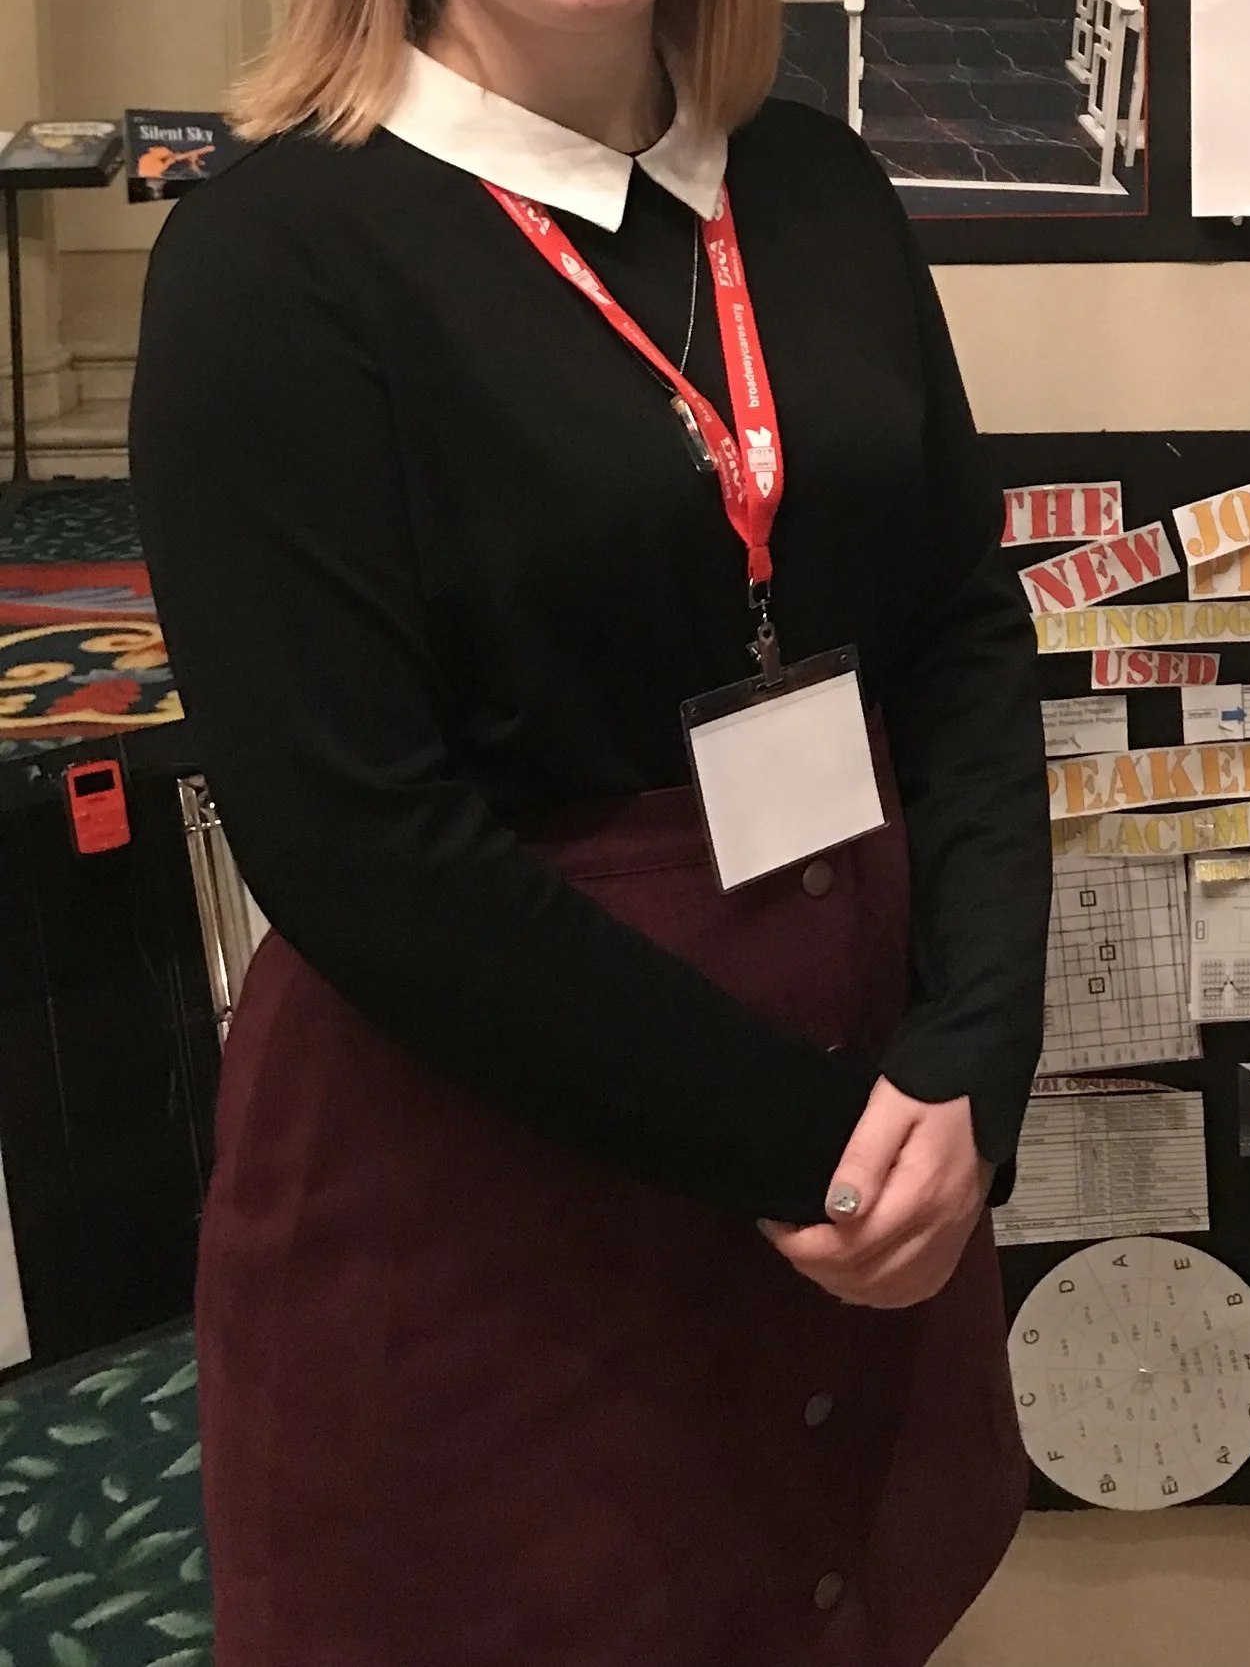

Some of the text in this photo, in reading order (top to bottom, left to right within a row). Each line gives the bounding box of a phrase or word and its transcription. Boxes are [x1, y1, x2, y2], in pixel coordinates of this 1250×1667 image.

[140, 125, 214, 143] Silent Sky
[732, 303, 760, 408] broadwaycares.org
[1024, 527, 1164, 613] NEW
[1093, 649, 1217, 687] USED
